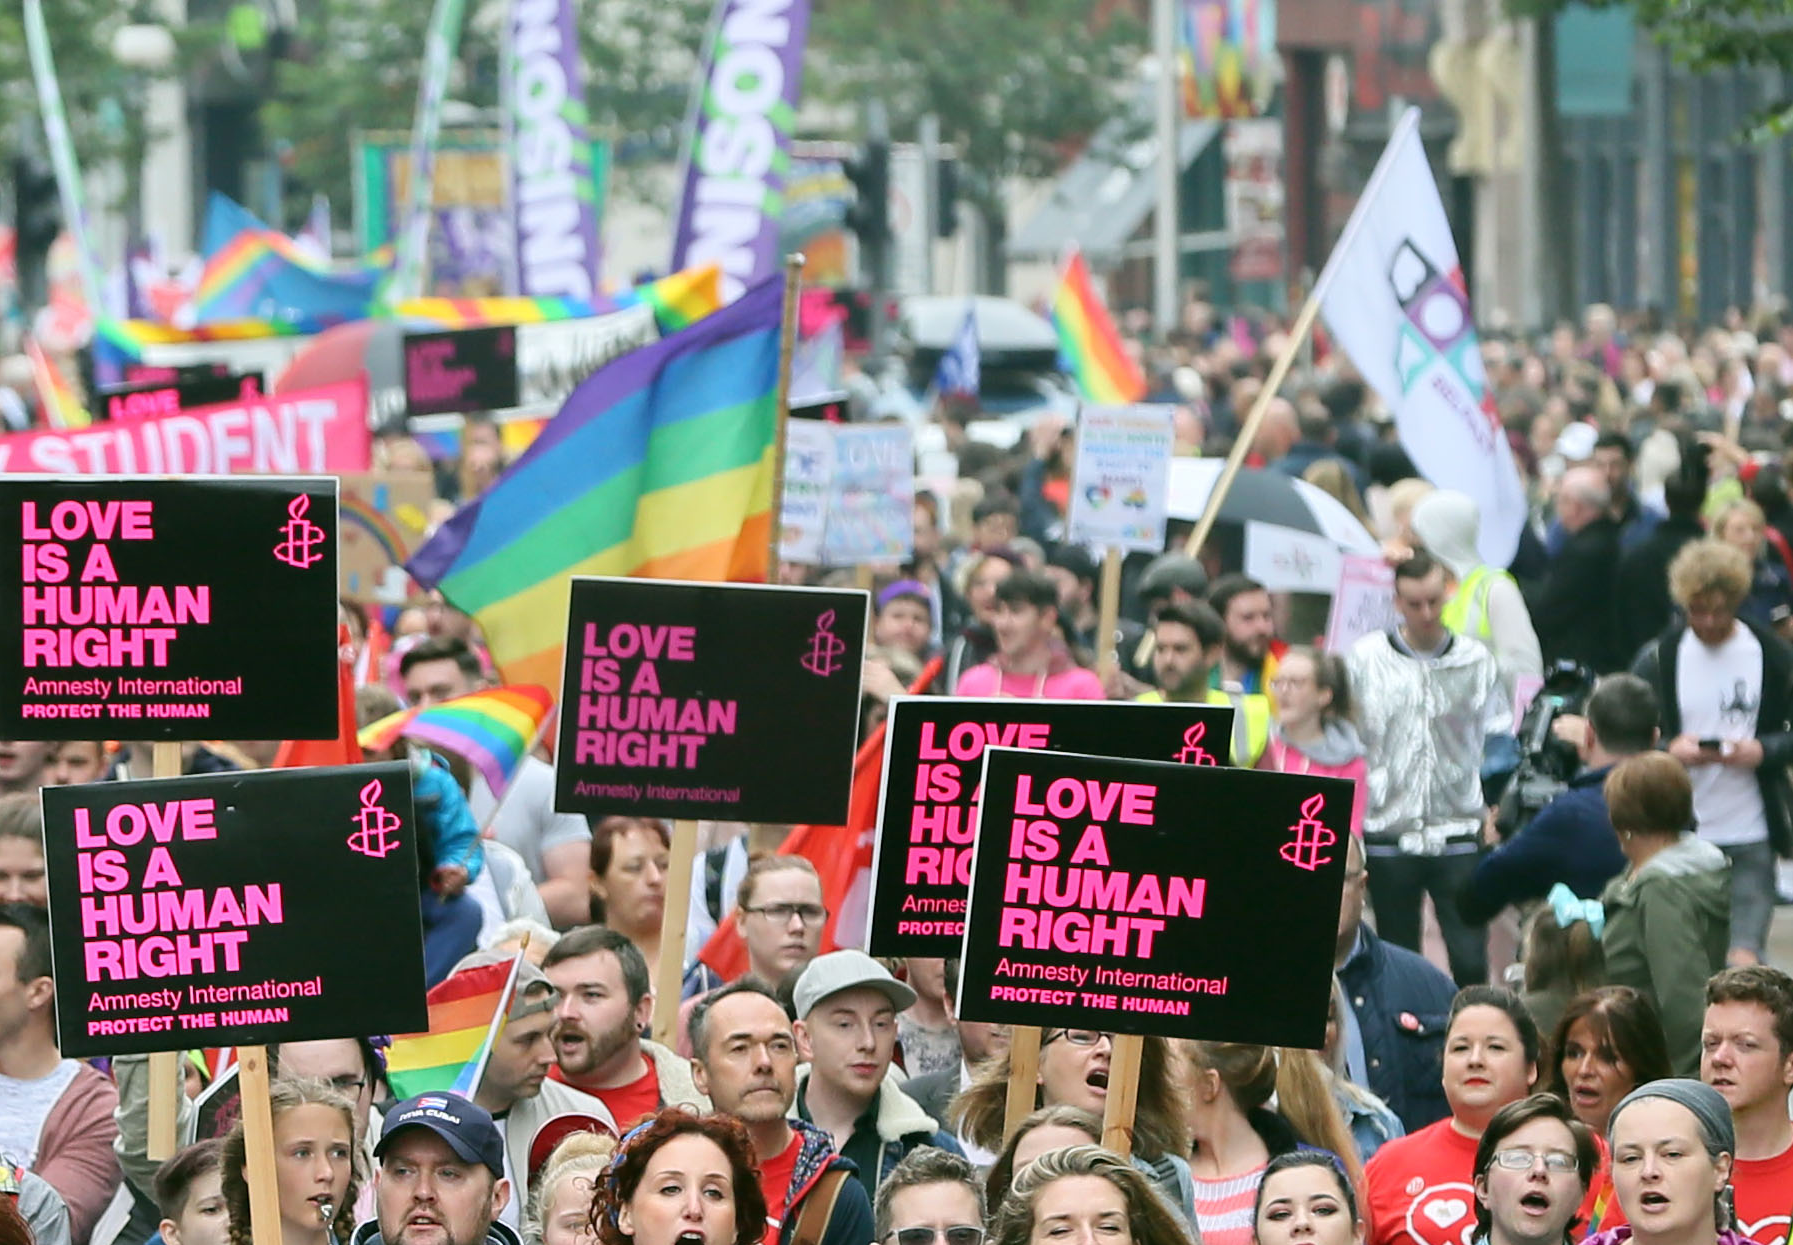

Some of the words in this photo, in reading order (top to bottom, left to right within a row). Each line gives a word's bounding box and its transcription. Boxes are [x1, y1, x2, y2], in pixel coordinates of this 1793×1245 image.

[680, 0, 792, 302] NISON
[21, 500, 155, 541] LOVE
[22, 543, 70, 583] IS
[80, 543, 119, 583] A
[22, 586, 210, 625] HUMAN
[22, 628, 177, 668] RIGHT
[583, 622, 697, 662] LOVE
[23, 676, 112, 700] Amnesty
[118, 676, 242, 696] International
[580, 657, 621, 693] IS
[630, 660, 662, 696] A
[22, 704, 103, 719] PROTECT
[107, 704, 142, 718] THE
[146, 703, 210, 718] HUMAN
[578, 694, 738, 735] HUMAN
[575, 730, 707, 769] RIGHT
[918, 721, 1051, 762] LOVE
[574, 780, 643, 803] Amnesty
[646, 784, 741, 803] International
[914, 763, 962, 803] IS
[1013, 774, 1158, 826] LOVE
[74, 798, 218, 849] LOVE
[1009, 818, 1060, 863] IS
[1070, 825, 1110, 867] A
[77, 850, 129, 893] IS
[142, 846, 183, 889] A
[80, 882, 284, 938] HUMAN
[901, 893, 968, 914] Amnes
[1003, 861, 1207, 919] HUMAN
[898, 920, 965, 937] PROTEC
[998, 906, 1166, 959] RIGHT
[83, 929, 250, 983] RIGHT
[88, 987, 183, 1013] Amnesty
[188, 975, 323, 1005] International
[994, 957, 1091, 987] Amnesty
[1095, 965, 1229, 996] International
[990, 984, 1077, 1006] PROTECT
[1081, 992, 1117, 1010] THE
[1121, 994, 1191, 1016] HUMAN
[88, 1015, 174, 1037] PROTECT
[178, 1012, 217, 1030] THE
[221, 1007, 290, 1027] HUMAN
